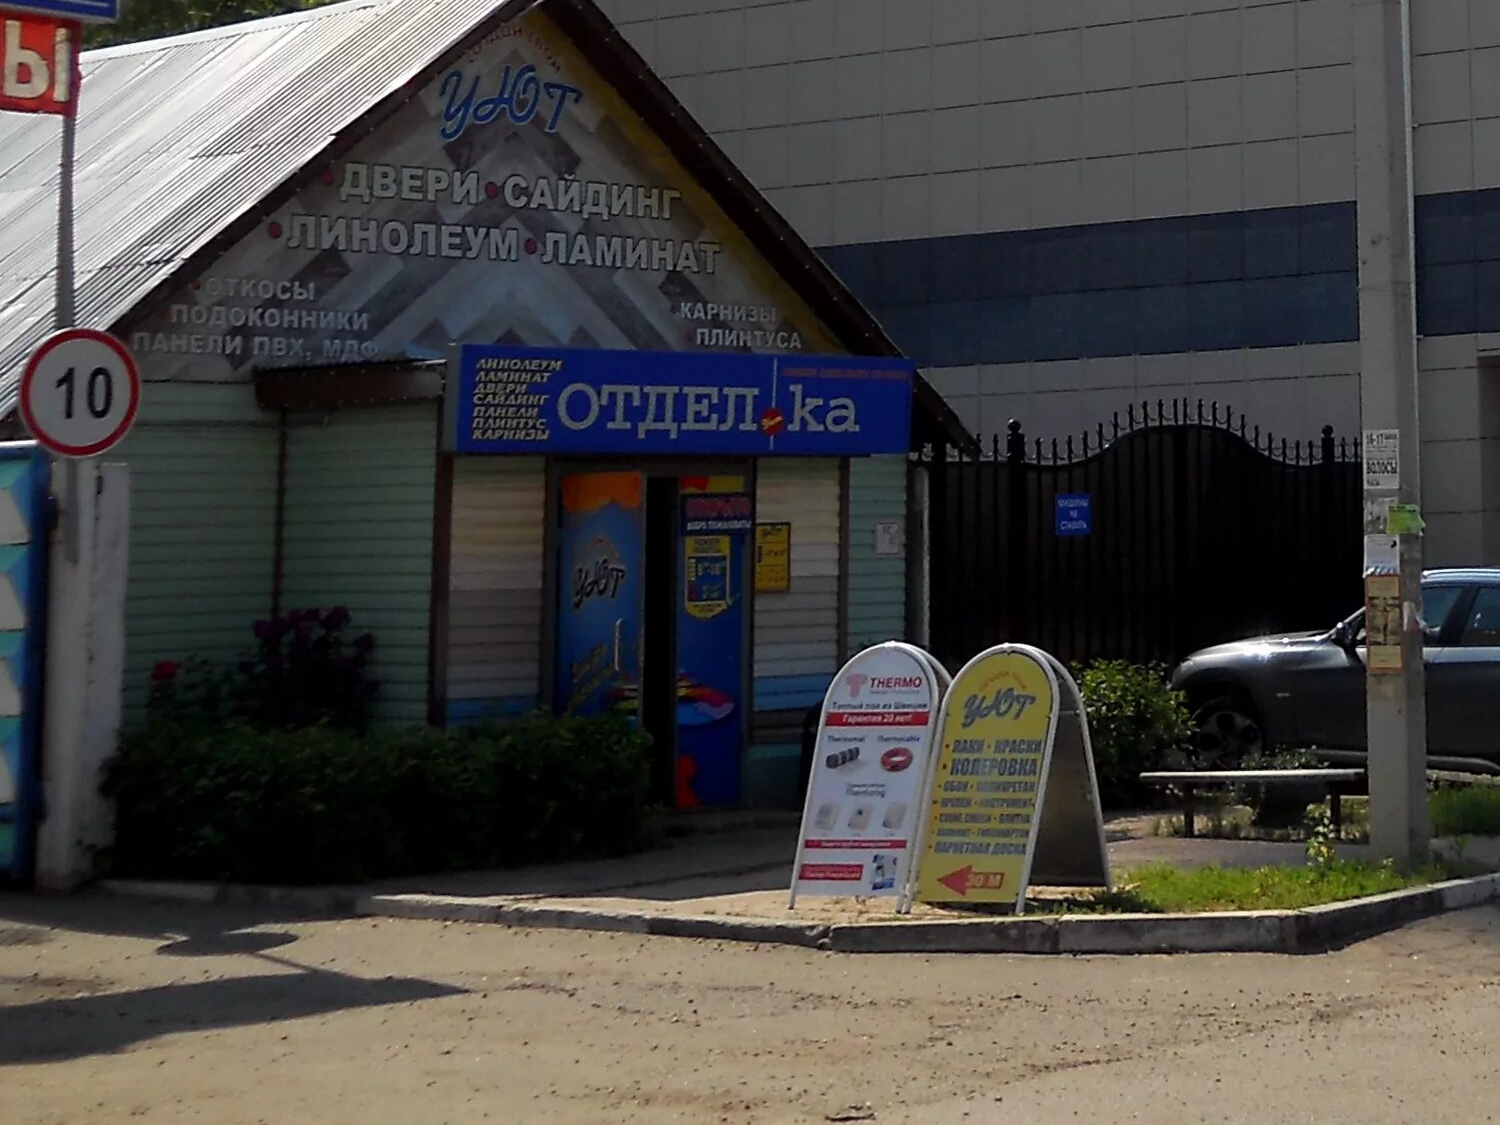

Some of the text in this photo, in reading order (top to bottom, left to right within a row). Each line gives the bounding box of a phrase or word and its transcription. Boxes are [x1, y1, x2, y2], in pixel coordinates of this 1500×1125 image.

[440, 64, 583, 141] УЮТ
[340, 162, 681, 221] ДВЕРИ САЙДИНГ
[287, 214, 721, 274] ЛИНОЛЕУМ ЛАМИНАТ
[206, 277, 315, 301] ОТКОСЫ
[171, 304, 369, 330] ПОДОКОННИКИ
[680, 301, 776, 323] КАРНИЗЫ
[696, 327, 802, 349] ПЛИНТУСА
[133, 332, 379, 361] ПАНЕЛИ ПВХ, МДФ
[476, 358, 563, 371] ЛИНОЛЕУМ
[475, 371, 551, 383] ЛАМИНАТ
[56, 367, 113, 419] 10
[473, 383, 527, 394] ДВЕРИ
[473, 393, 549, 405] САЙДИНГ
[473, 406, 538, 417] ПАНЕЛИ
[472, 418, 546, 429] ПЛИНТУС
[472, 429, 549, 440] КАРНИЗЫ
[1366, 461, 1397, 474] ВОЛОСЫ
[573, 558, 626, 609] УЮТ
[870, 677, 922, 688] THERMO
[962, 688, 1036, 727] УЮТ
[952, 739, 1042, 753] ЛАКИ КРАСКИ
[950, 758, 1037, 776] КОЛЕРОВКА
[944, 781, 969, 792] ОБОИ
[965, 874, 984, 886] 30
